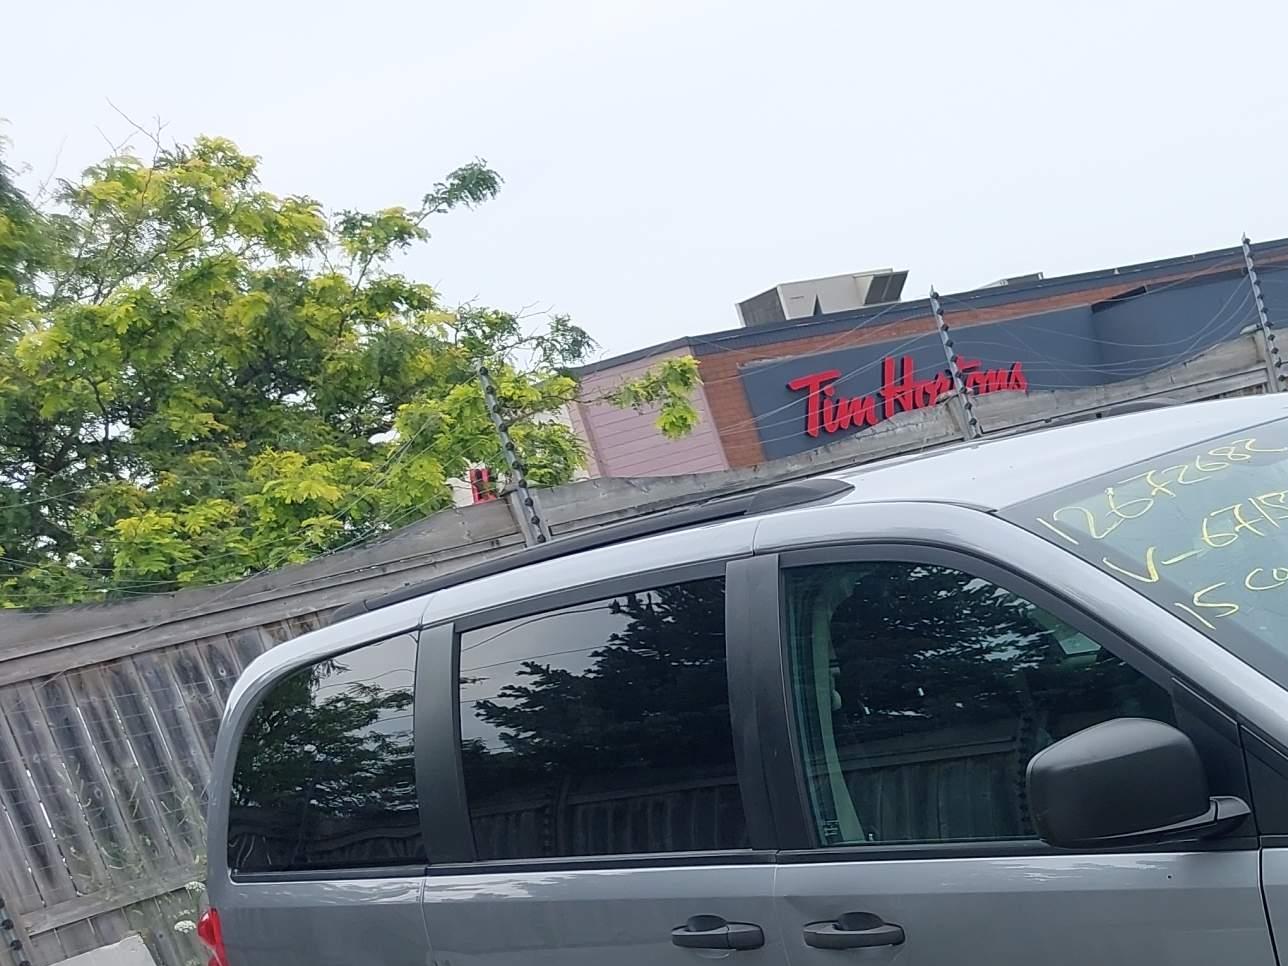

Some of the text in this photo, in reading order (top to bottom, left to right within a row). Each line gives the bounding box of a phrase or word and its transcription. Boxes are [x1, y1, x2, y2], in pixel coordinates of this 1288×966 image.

[787, 368, 879, 438] Tim
[1036, 438, 1288, 541] 12672682
[1174, 581, 1240, 630] 15
